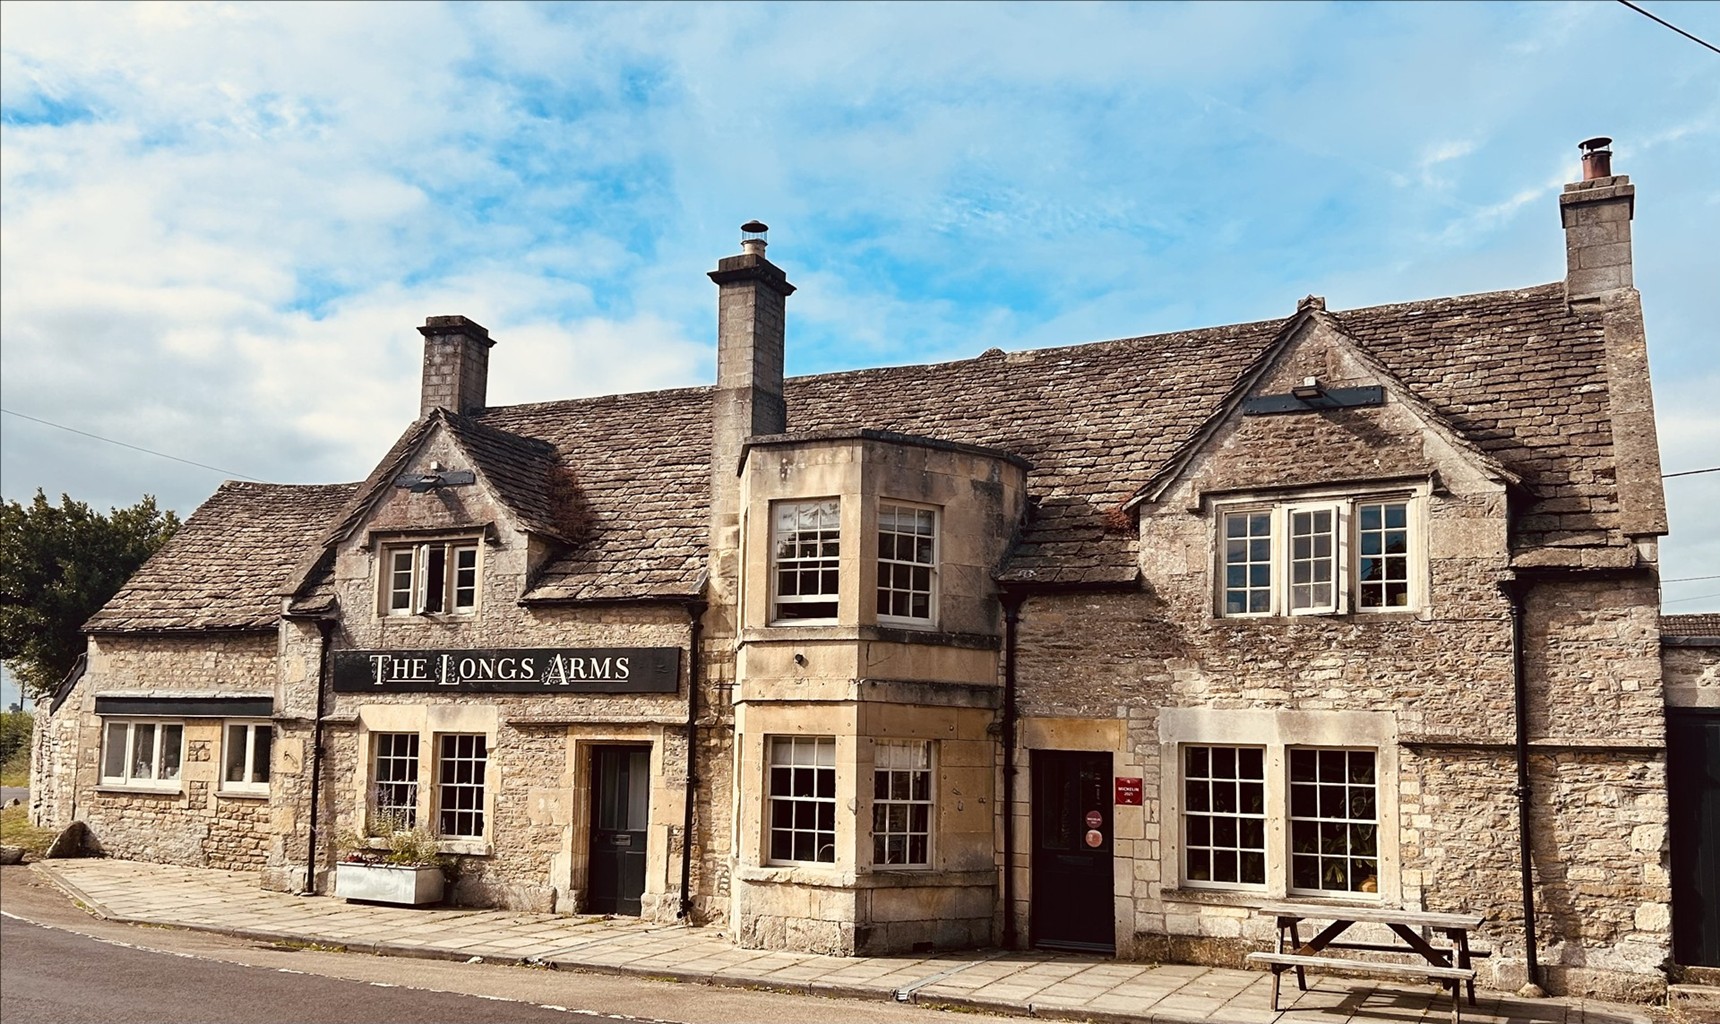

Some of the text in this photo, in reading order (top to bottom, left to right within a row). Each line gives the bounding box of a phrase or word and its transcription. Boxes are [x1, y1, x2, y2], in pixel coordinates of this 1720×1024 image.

[369, 653, 630, 687] THE LONGS ARMS
